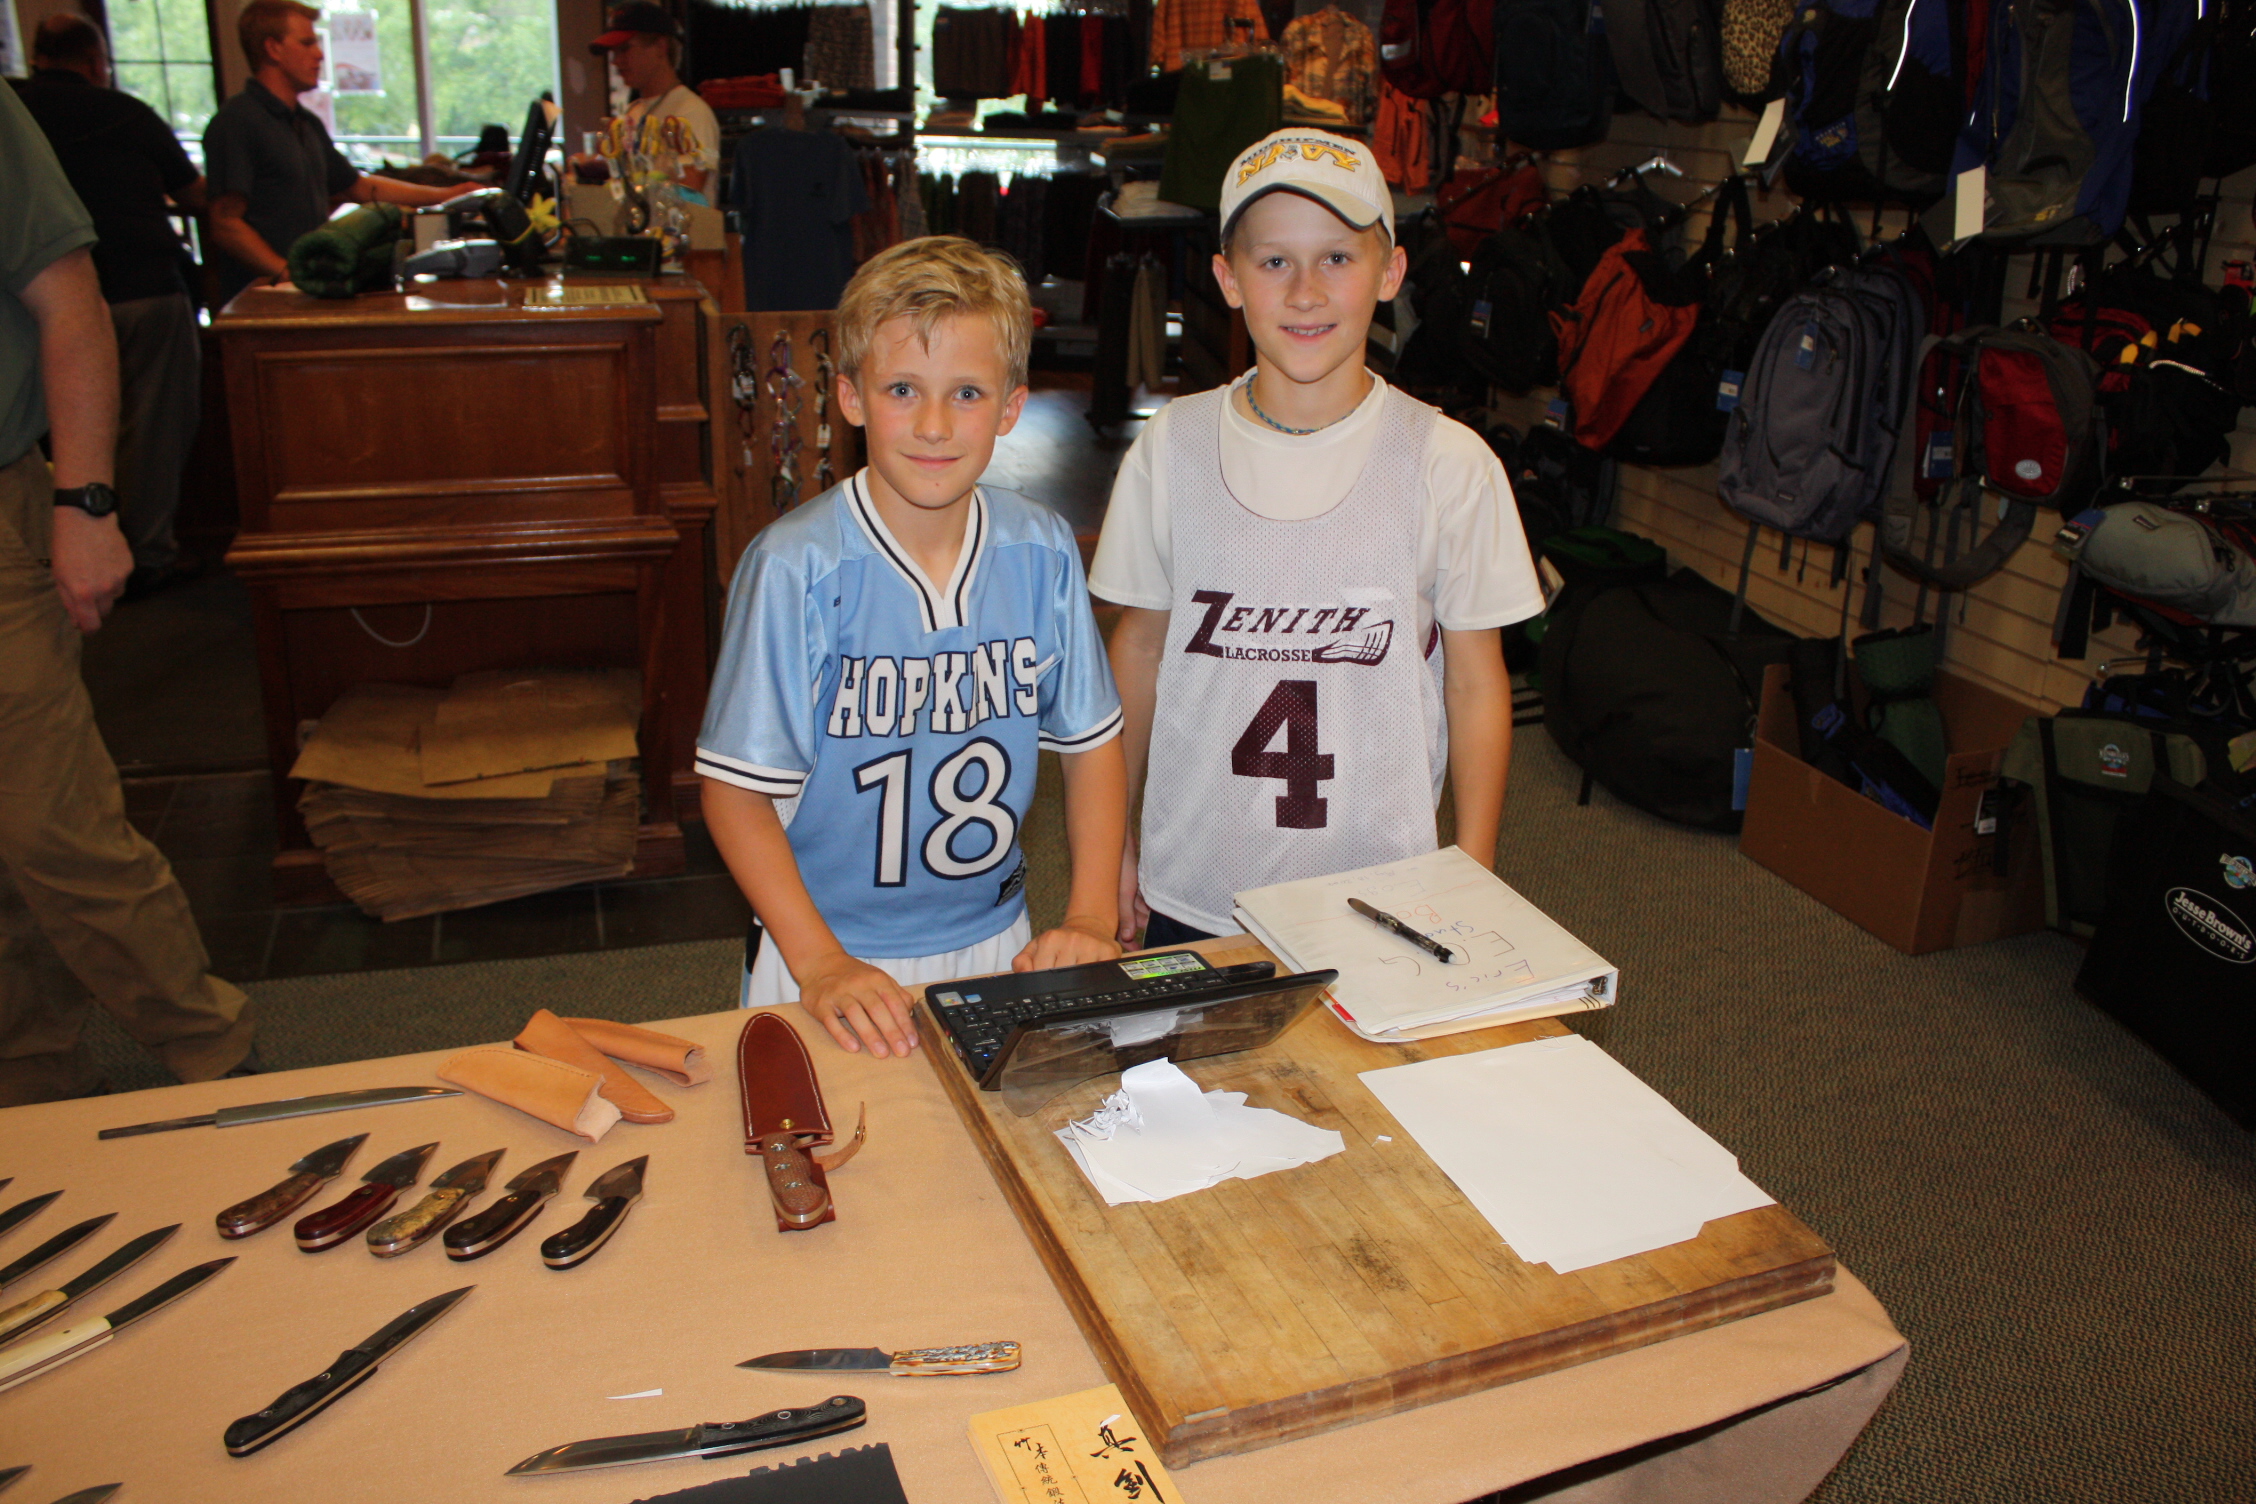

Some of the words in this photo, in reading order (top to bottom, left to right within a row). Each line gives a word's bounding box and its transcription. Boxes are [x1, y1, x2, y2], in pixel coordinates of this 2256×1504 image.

[1236, 144, 1361, 187] NAVY
[1184, 589, 1371, 658] ZENITH
[1224, 645, 1312, 662] LACROSSE
[1231, 679, 1335, 830] 4
[853, 736, 1019, 889] 18
[1445, 959, 1535, 992] Eric's
